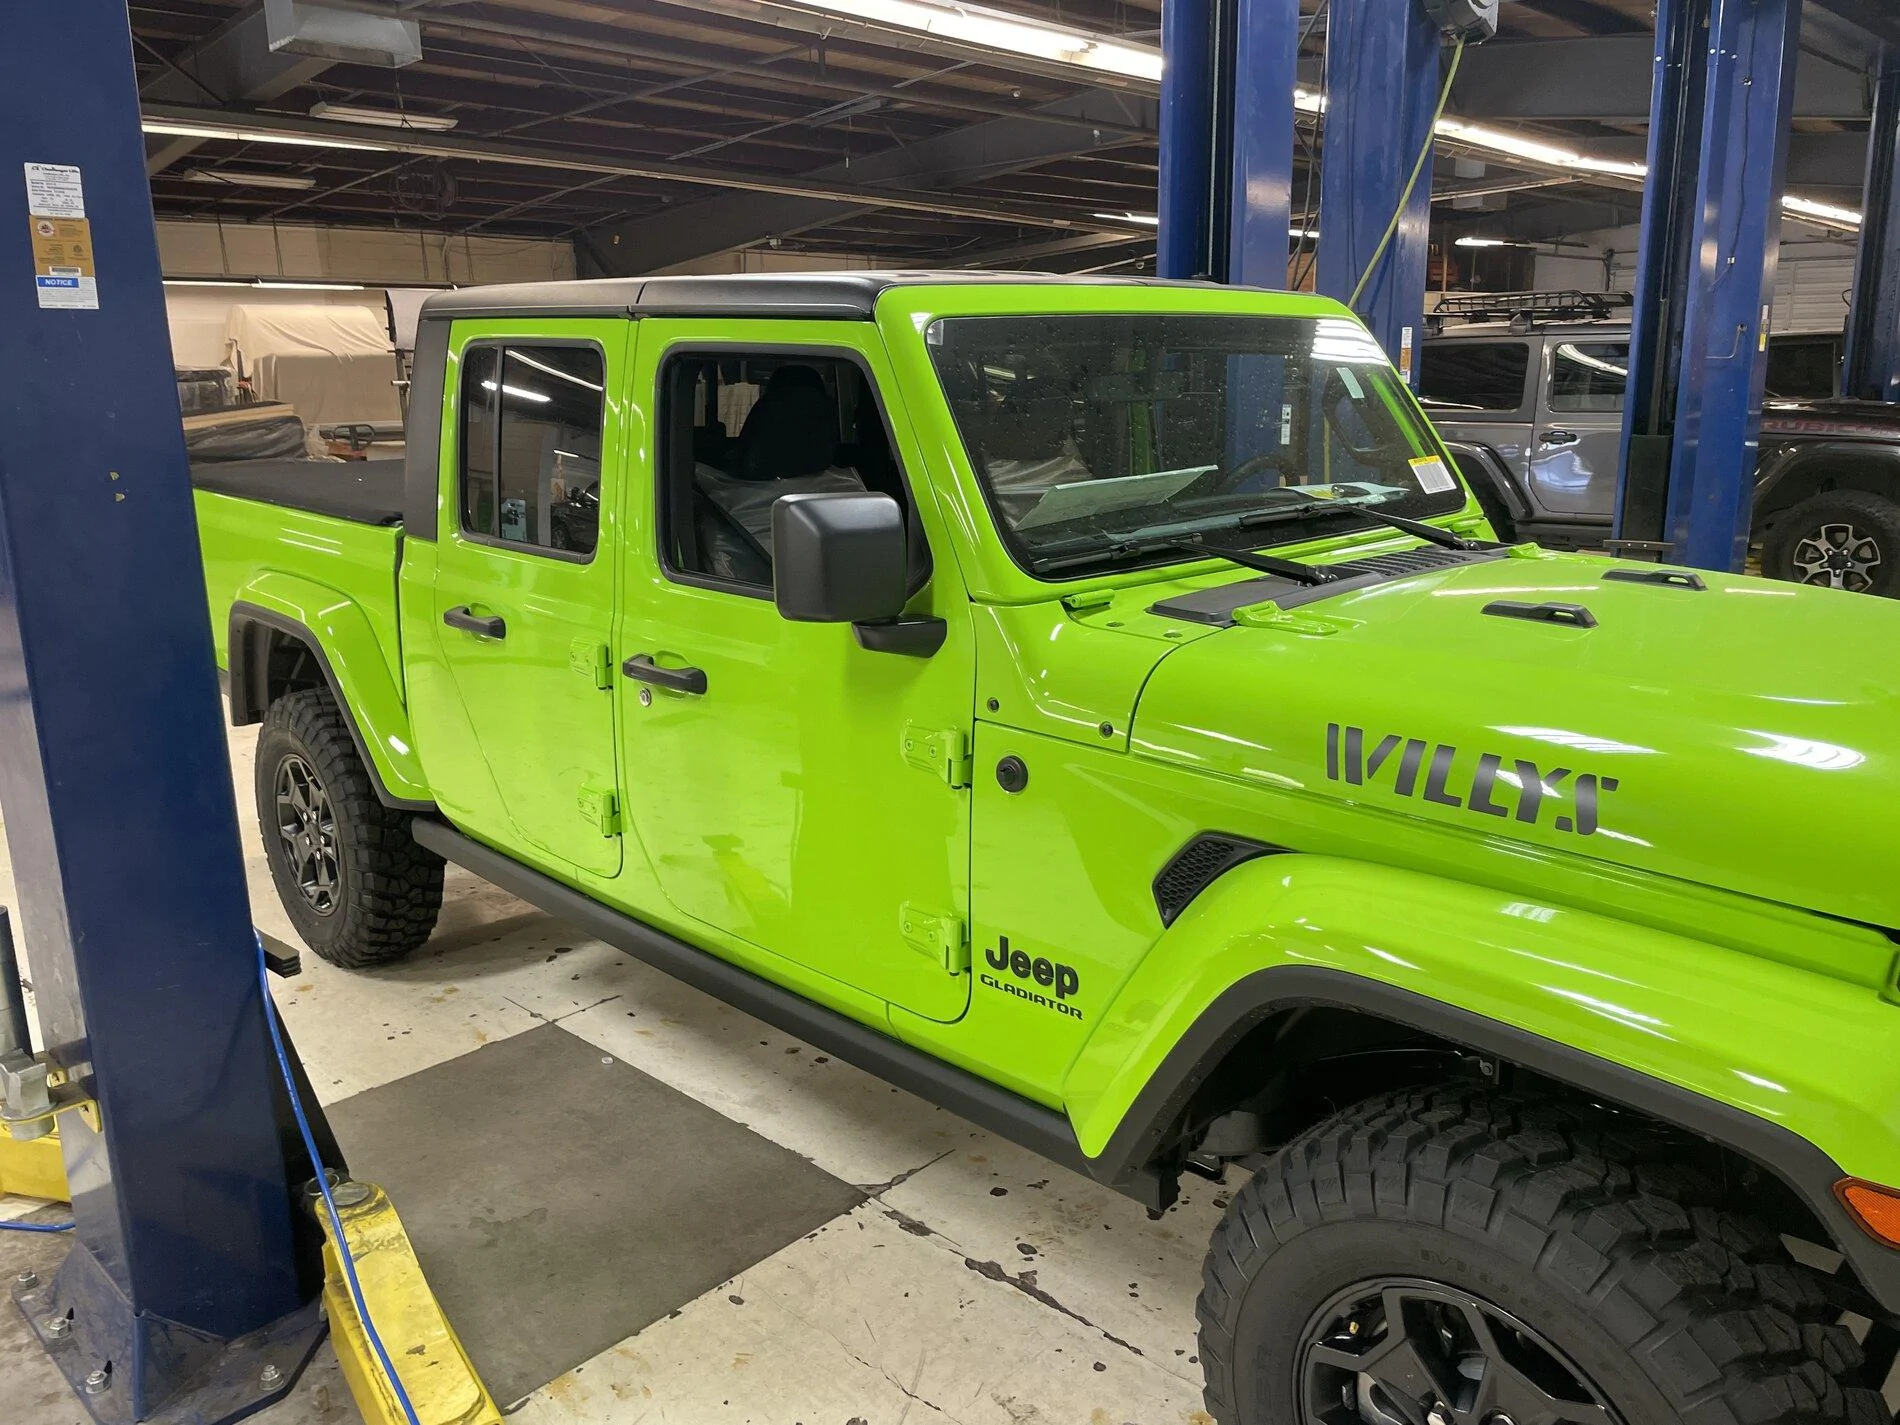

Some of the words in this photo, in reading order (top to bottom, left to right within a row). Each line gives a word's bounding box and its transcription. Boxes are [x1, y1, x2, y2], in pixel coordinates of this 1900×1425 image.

[1327, 722, 1619, 835] WILLYS
[980, 974, 1083, 1021] GLADIATOR
[985, 935, 1079, 1000] Jeep
